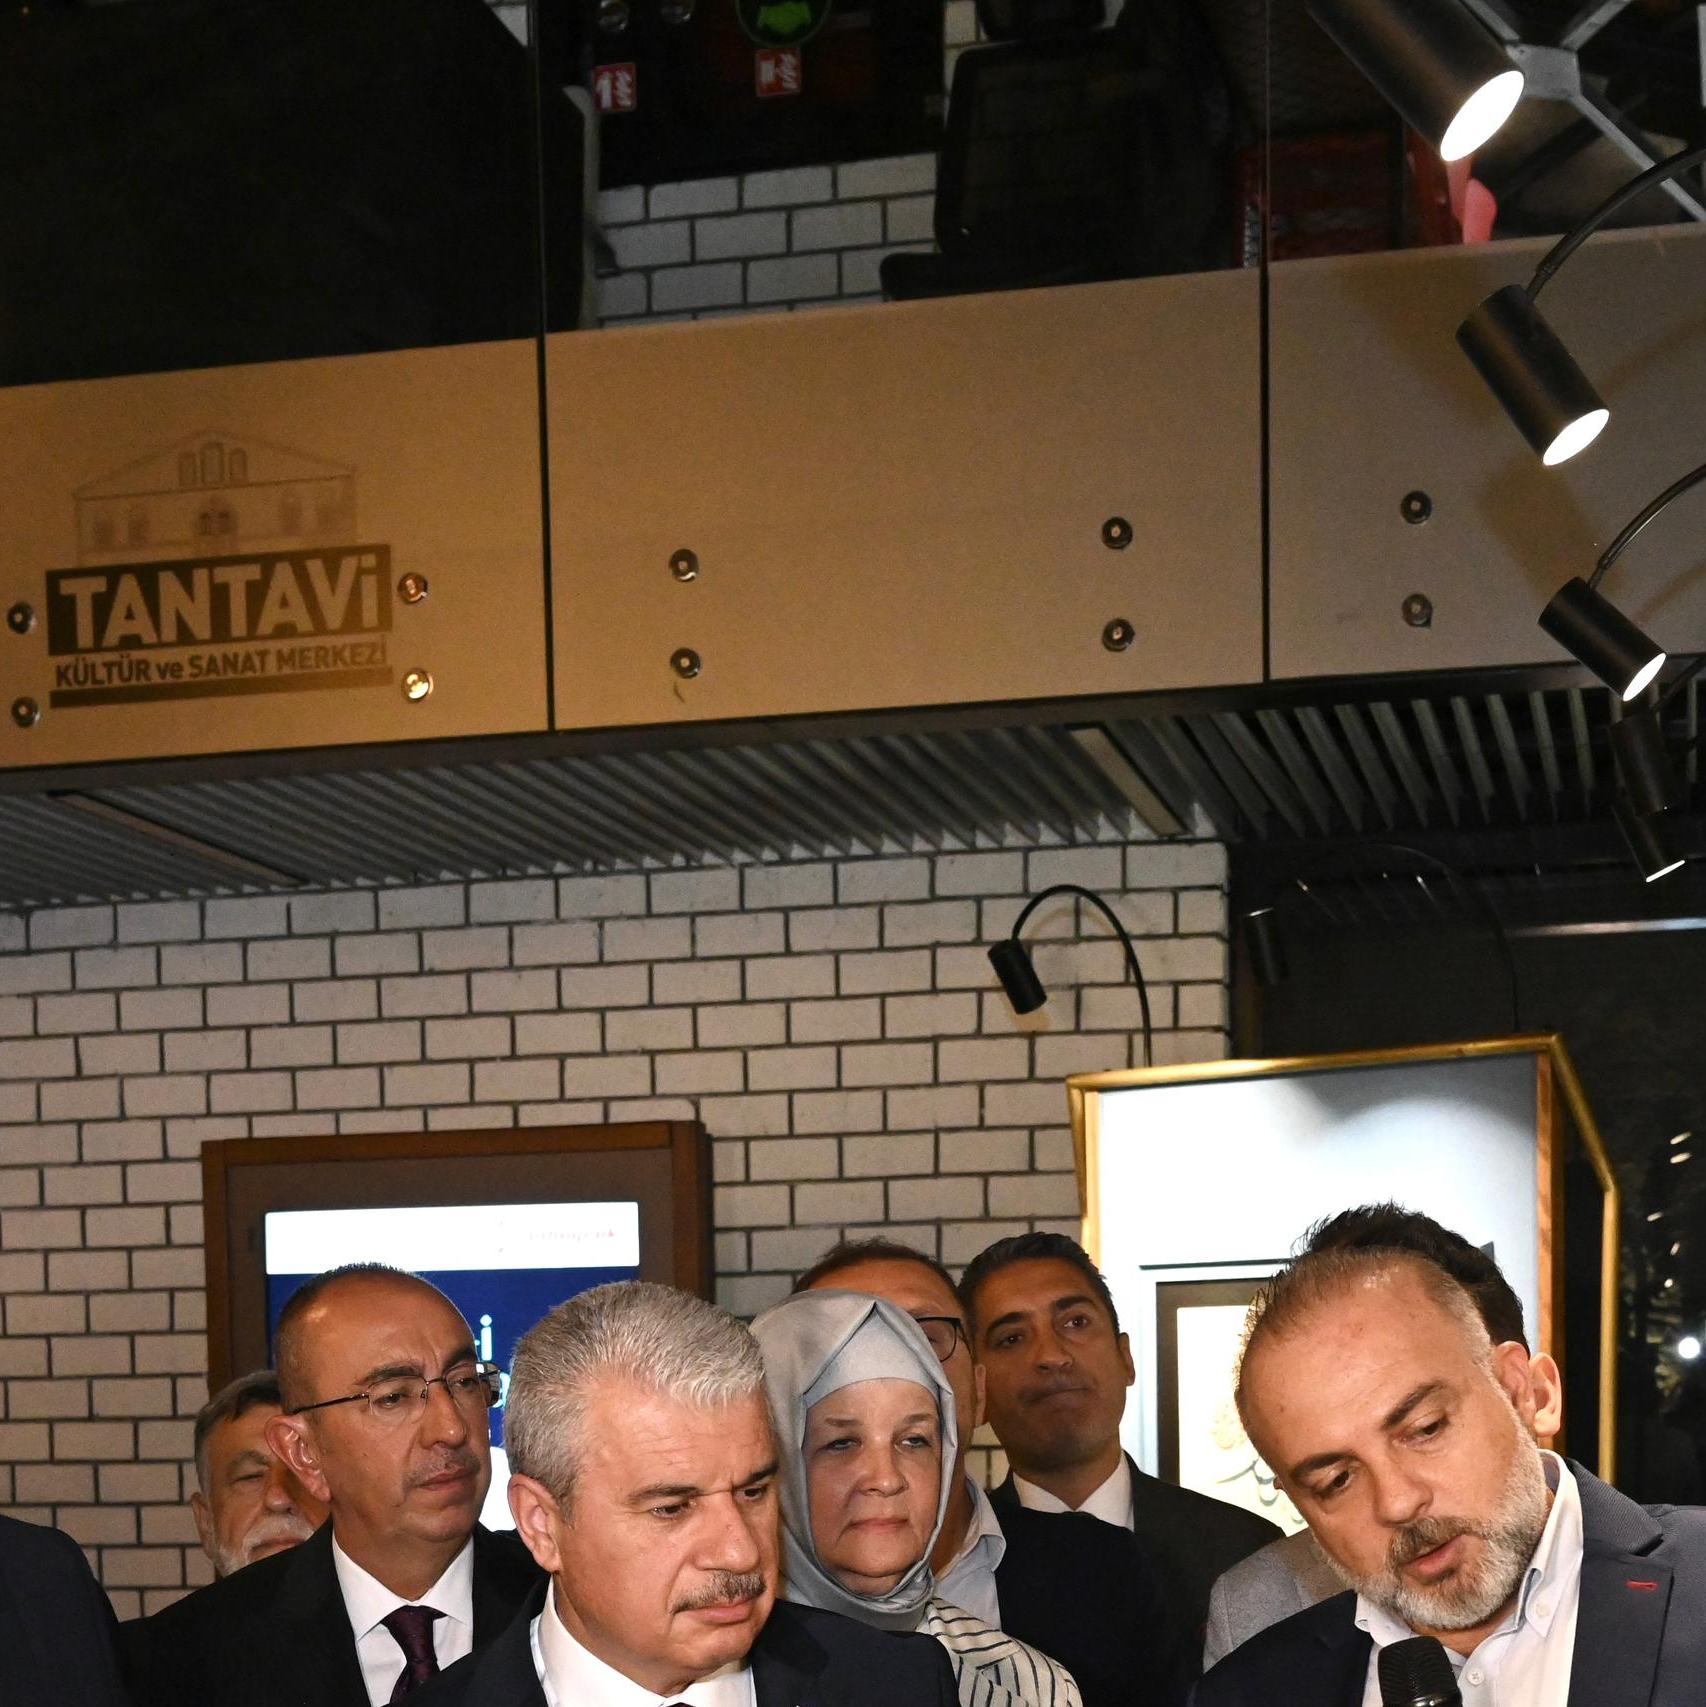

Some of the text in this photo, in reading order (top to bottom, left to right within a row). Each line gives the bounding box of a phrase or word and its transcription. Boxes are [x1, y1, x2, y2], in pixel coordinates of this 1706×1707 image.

[55, 634, 388, 688] KÜLTÜR ve SANAT MERKEZİ
